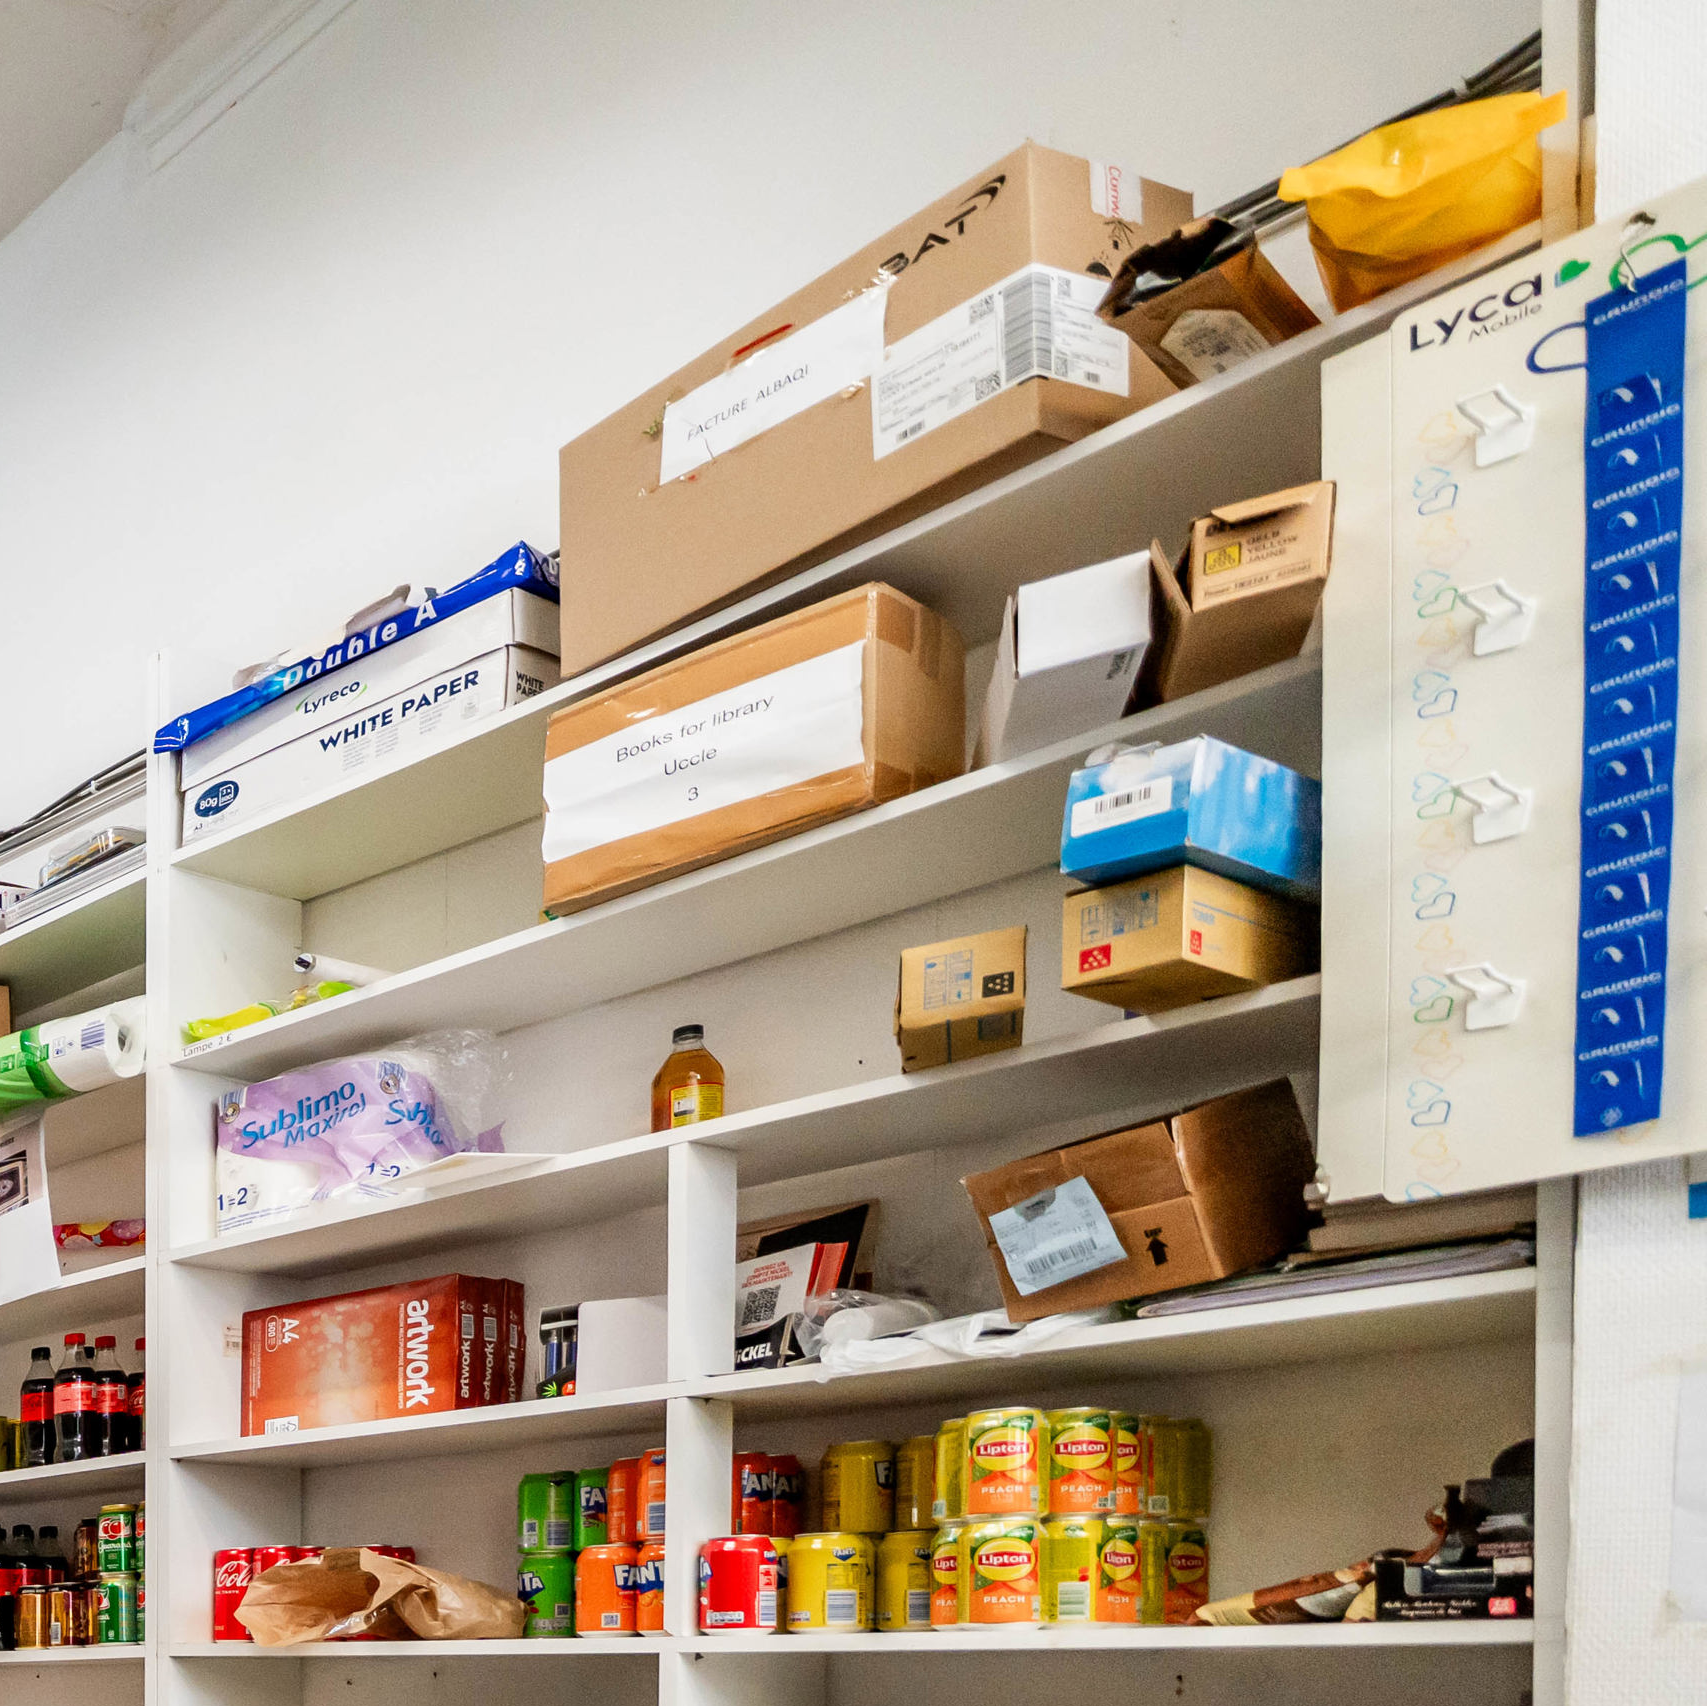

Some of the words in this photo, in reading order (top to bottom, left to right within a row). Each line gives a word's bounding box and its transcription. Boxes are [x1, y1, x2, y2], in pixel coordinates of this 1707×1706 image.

[1410, 272, 1543, 352] Lyca
[1469, 301, 1542, 342] Mobile
[687, 399, 747, 440] FACTURE
[283, 624, 398, 692] Double
[415, 601, 437, 627] A
[516, 671, 544, 690] WHITE
[304, 681, 361, 716] Lyreco
[319, 707, 395, 754] WHITE
[402, 670, 480, 718] PAPER
[615, 728, 673, 763] Books
[679, 717, 705, 740] for
[711, 696, 775, 730] library
[663, 747, 718, 777] Uccle
[199, 798, 218, 810] 80g
[687, 788, 698, 801] 3
[181, 1042, 213, 1057] Lampe
[218, 1037, 225, 1046] 2
[241, 1082, 356, 1149] Sublimo
[284, 1092, 366, 1148] Maxirol
[282, 1318, 299, 1344] A4
[405, 1299, 431, 1409] artwork
[460, 1339, 471, 1399] artwork
[484, 1340, 495, 1401] artwork
[979, 1443, 1026, 1456] Lipton
[1059, 1443, 1104, 1453] Lipton
[981, 1484, 1023, 1493] PEACH
[1060, 1484, 1102, 1493] PEACH
[981, 1553, 1028, 1566] Lipton
[983, 1595, 1026, 1603] PEACH
